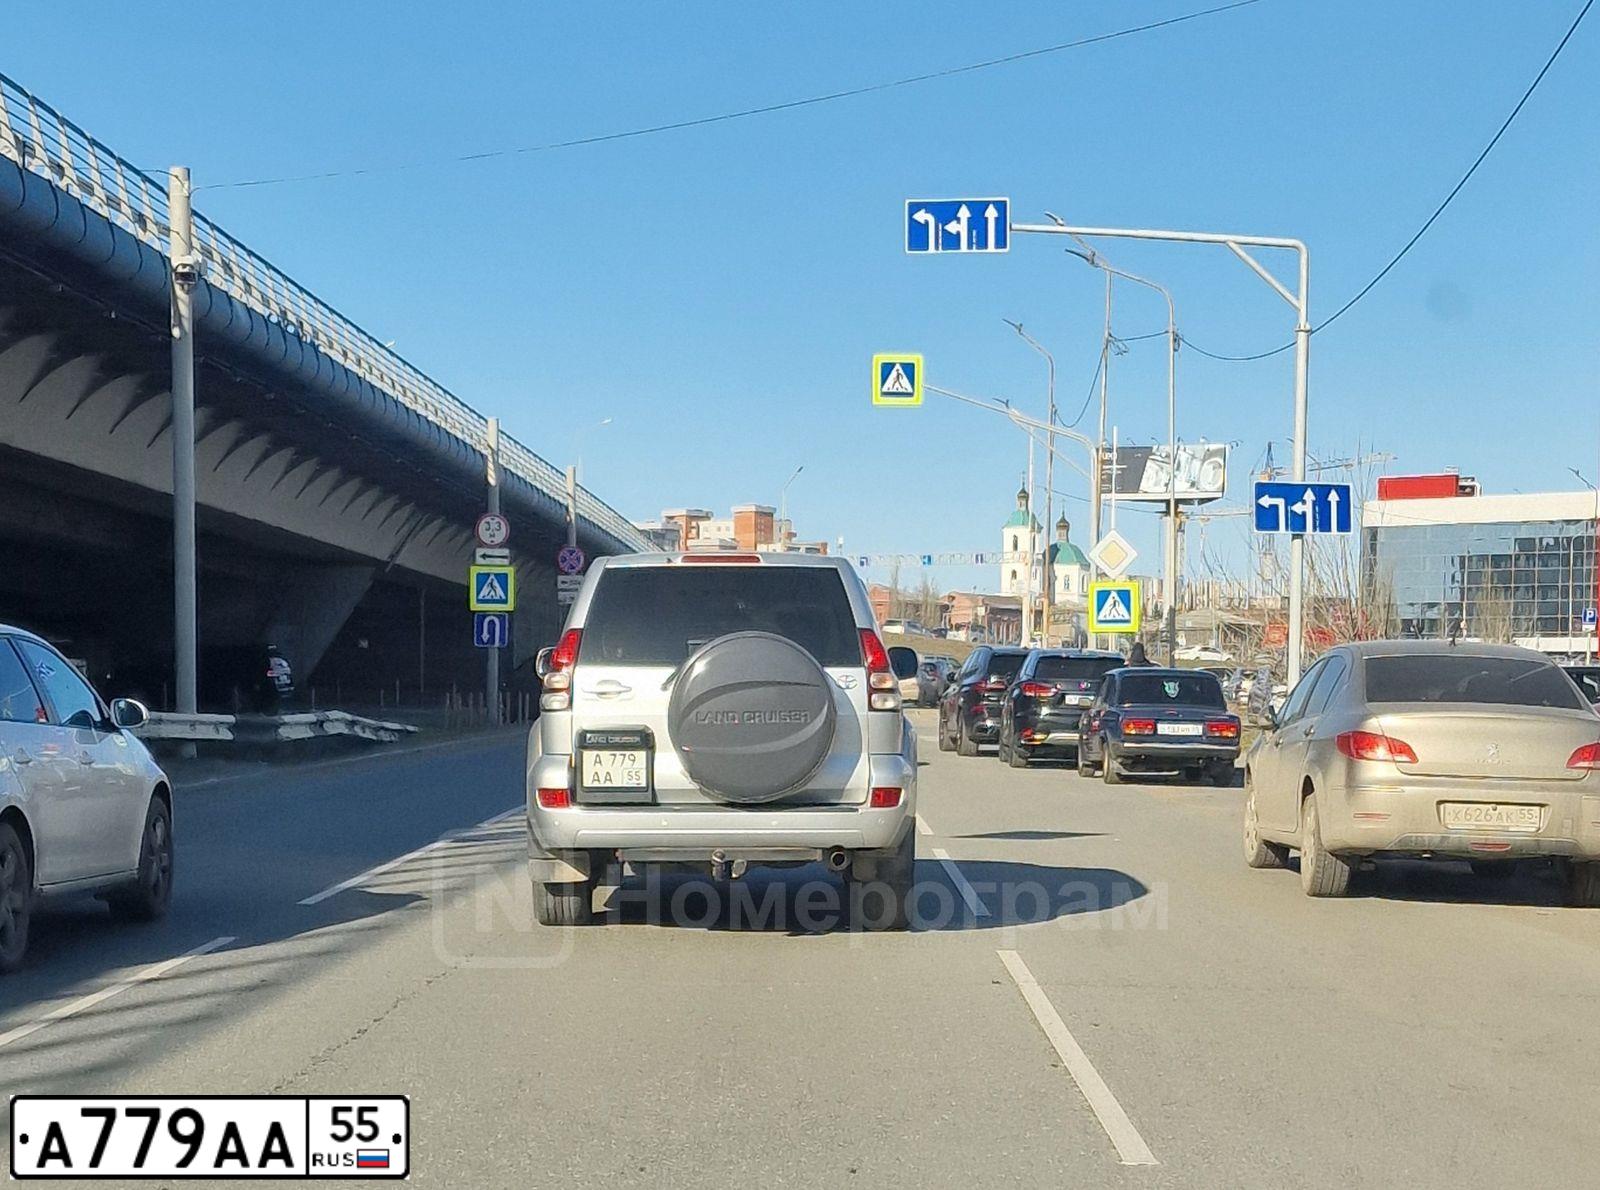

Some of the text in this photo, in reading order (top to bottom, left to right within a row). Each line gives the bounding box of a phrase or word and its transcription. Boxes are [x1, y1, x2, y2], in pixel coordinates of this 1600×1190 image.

[696, 710, 811, 724] LAND CRUISER
[609, 753, 636, 768] 779
[626, 770, 641, 781] 55
